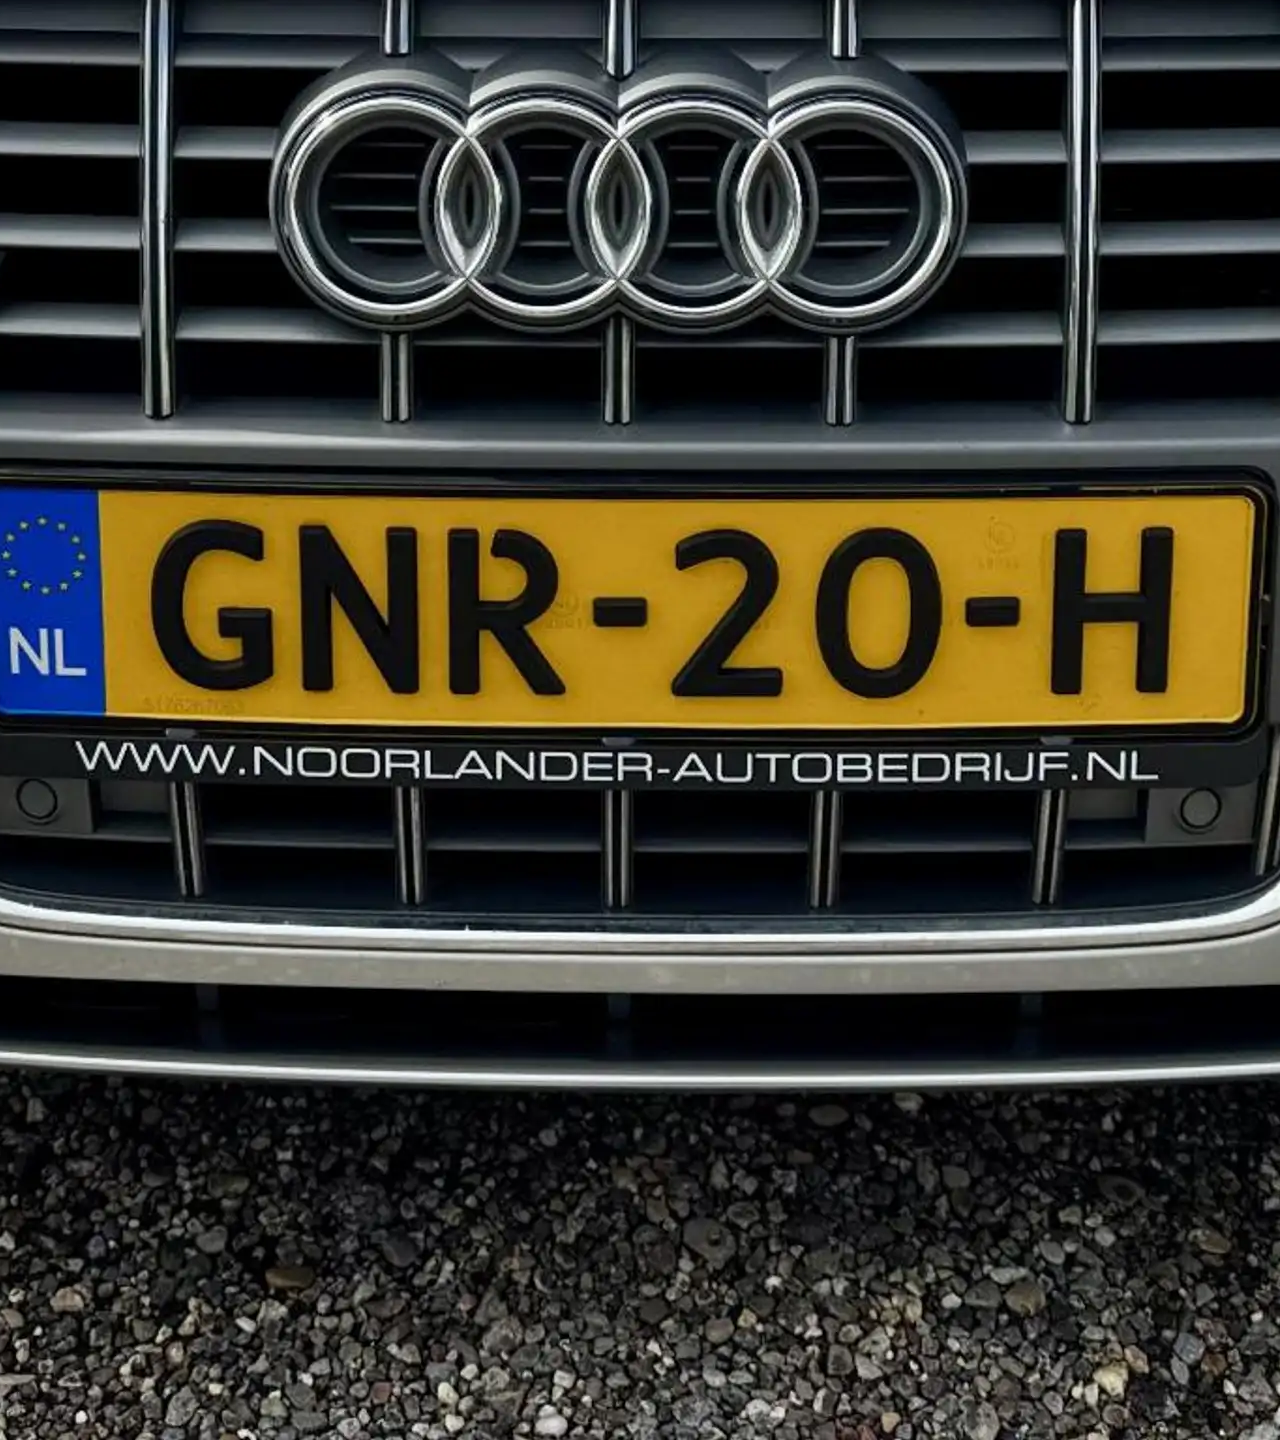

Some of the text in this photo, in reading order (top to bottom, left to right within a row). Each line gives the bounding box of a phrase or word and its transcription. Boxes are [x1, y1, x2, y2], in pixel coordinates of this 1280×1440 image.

[9, 519, 1174, 698] NL GNR-20-H
[75, 741, 1159, 783] WWW.NOORLANDER-AUTOBEDRIJF.NL
